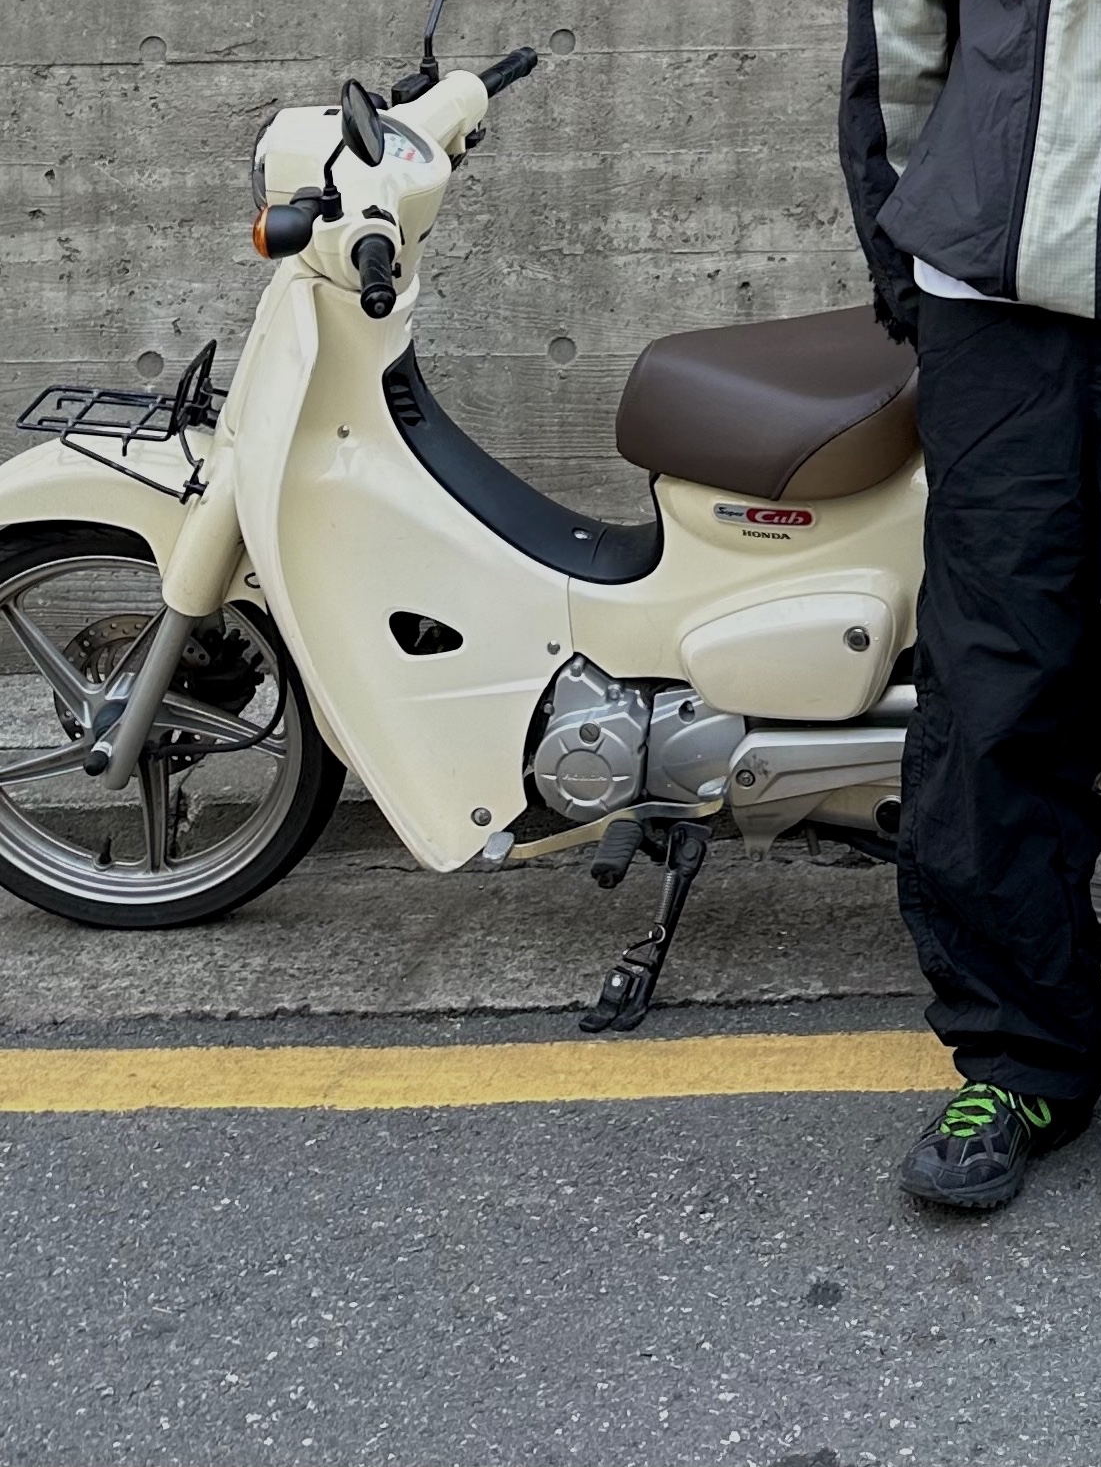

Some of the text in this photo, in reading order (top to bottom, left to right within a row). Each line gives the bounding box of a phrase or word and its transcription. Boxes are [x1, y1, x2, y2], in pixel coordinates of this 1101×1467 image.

[716, 506, 805, 524] Super Cub
[741, 529, 791, 540] HONDA
